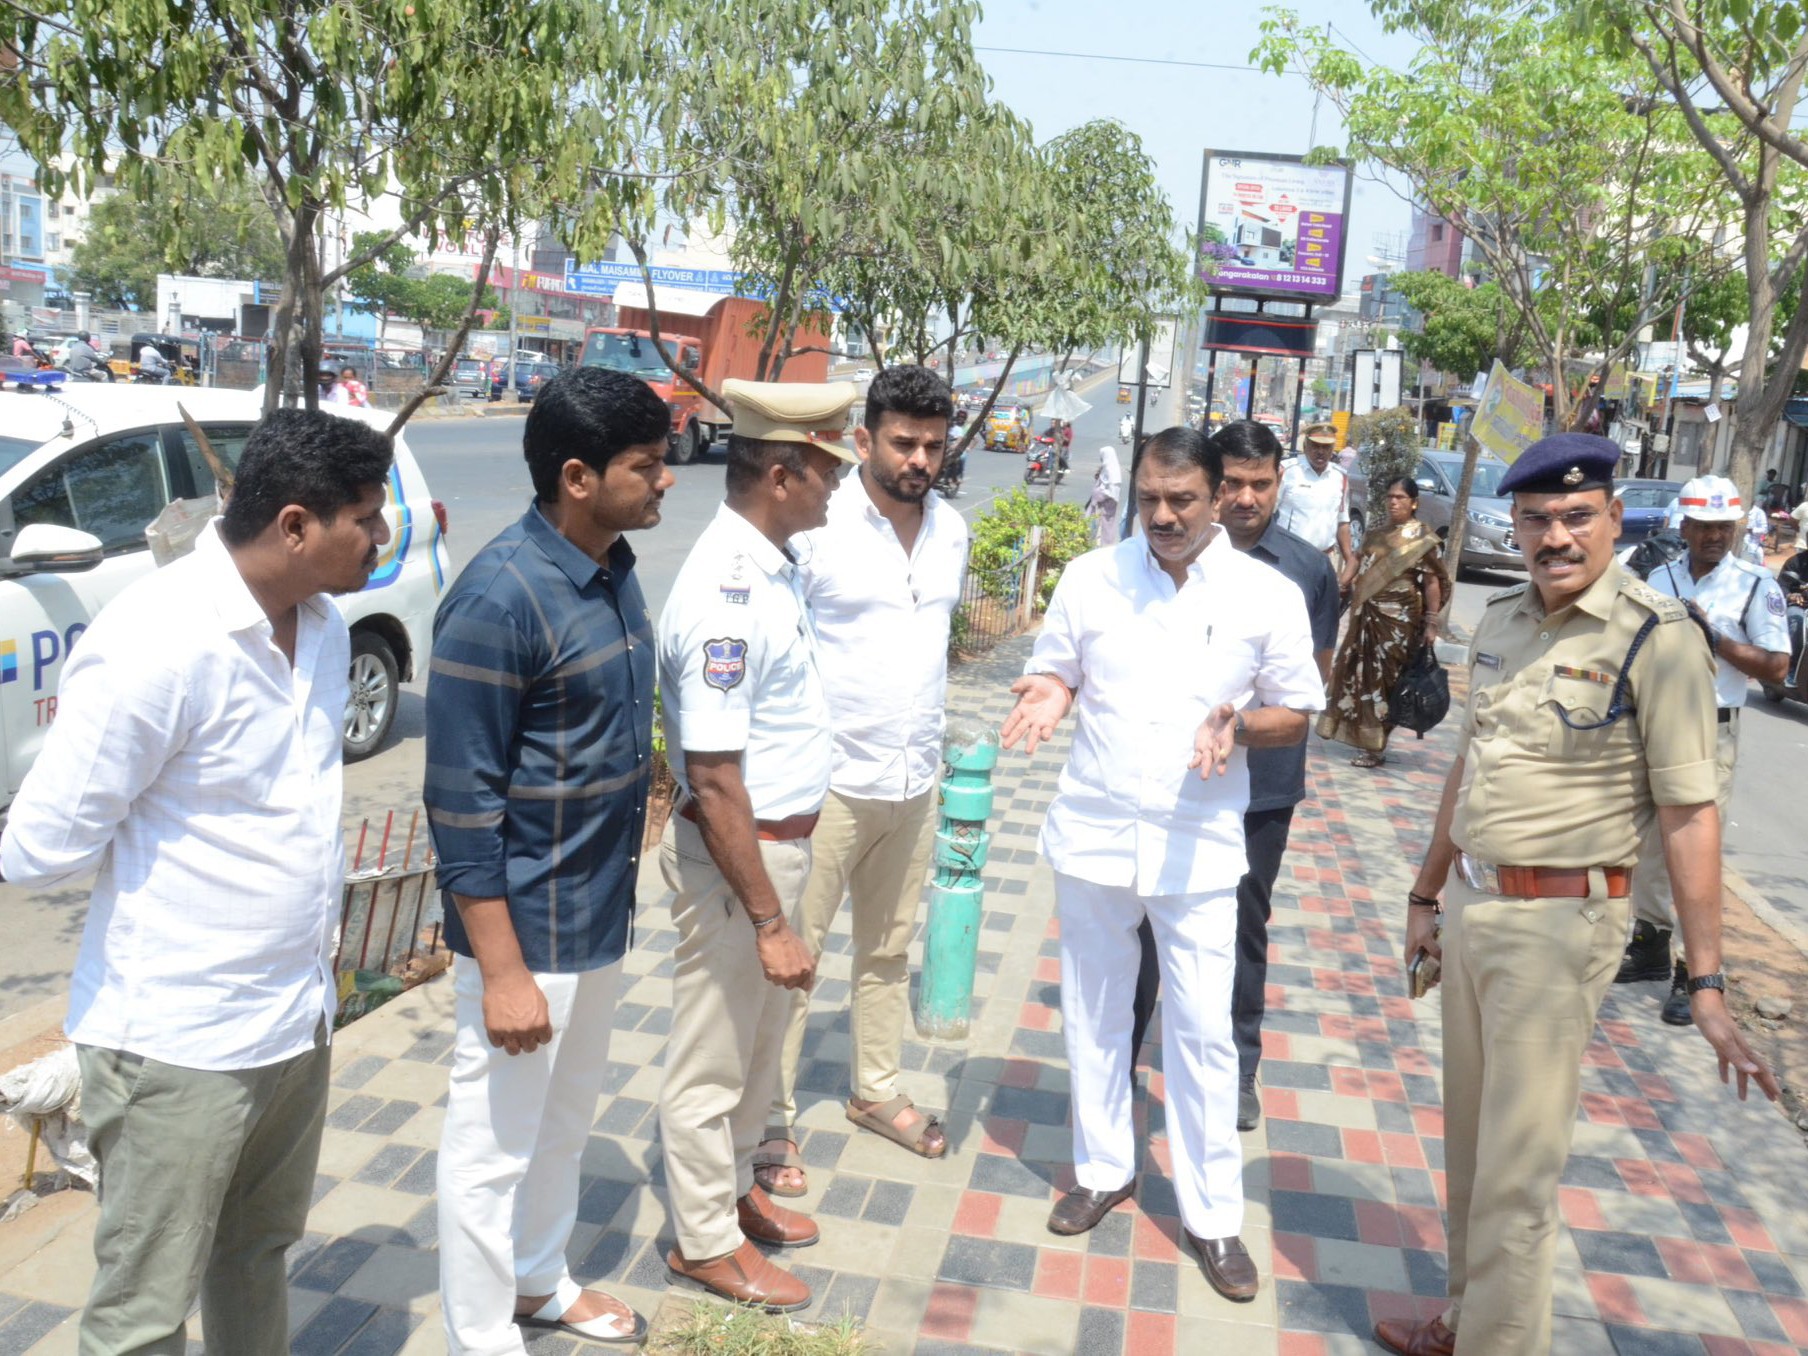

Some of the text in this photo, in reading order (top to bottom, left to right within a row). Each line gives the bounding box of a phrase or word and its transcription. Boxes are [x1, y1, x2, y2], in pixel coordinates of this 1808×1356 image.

[652, 269, 694, 281] FLYOVER
[1213, 269, 1270, 282] ongarakalan
[1311, 275, 1327, 286] 333
[709, 662, 743, 672] POLICE
